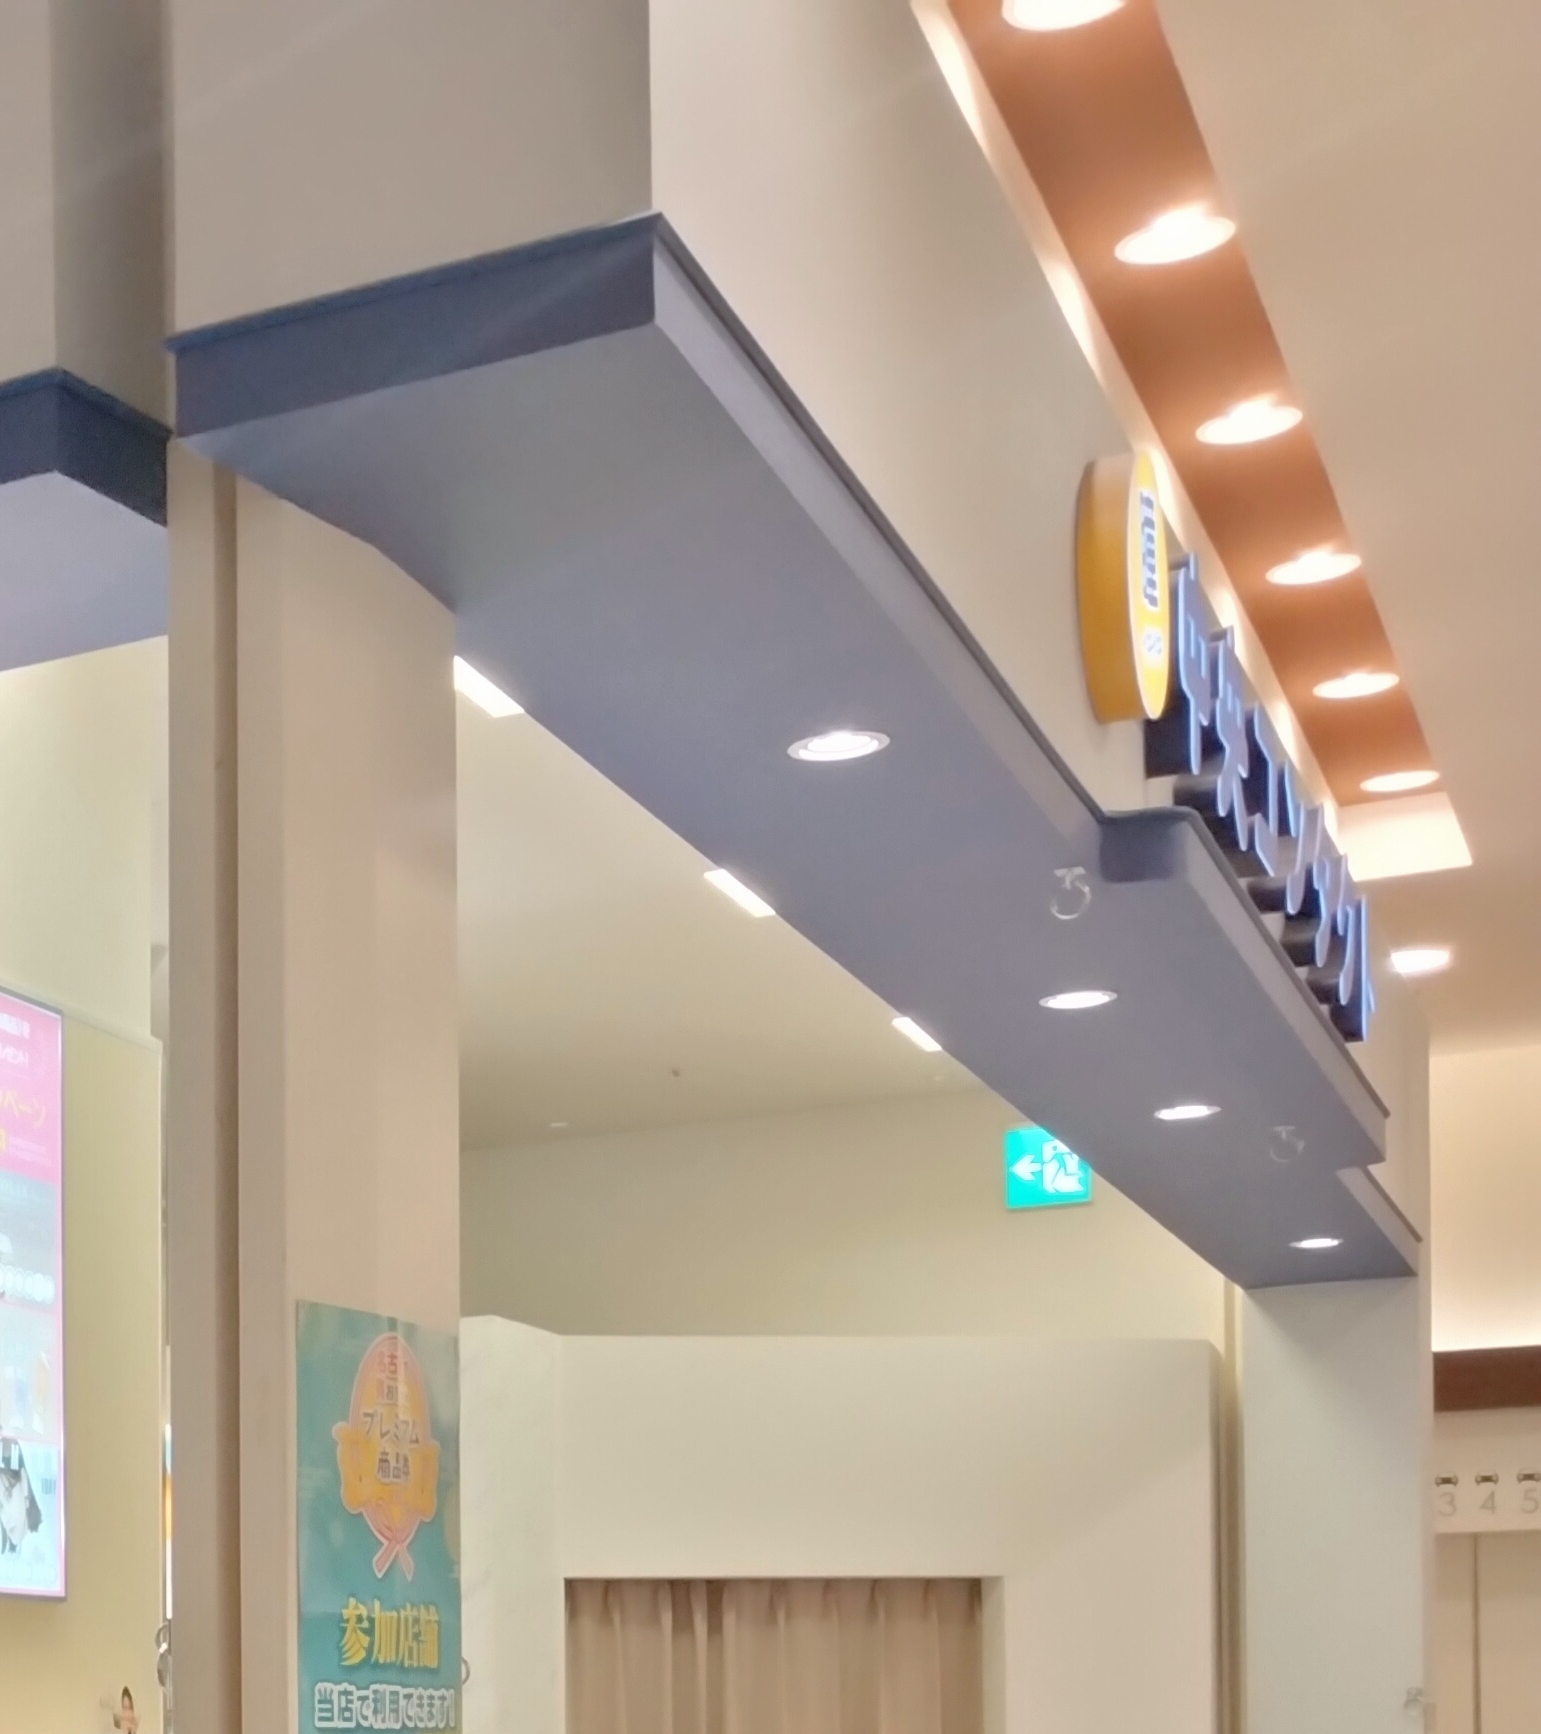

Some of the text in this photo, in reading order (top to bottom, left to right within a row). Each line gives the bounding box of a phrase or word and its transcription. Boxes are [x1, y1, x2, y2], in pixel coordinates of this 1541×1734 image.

[1439, 1491, 1458, 1518] 3
[1479, 1489, 1497, 1515] 4
[1520, 1487, 1539, 1514] 5
[338, 1596, 440, 1669] 参加店舗
